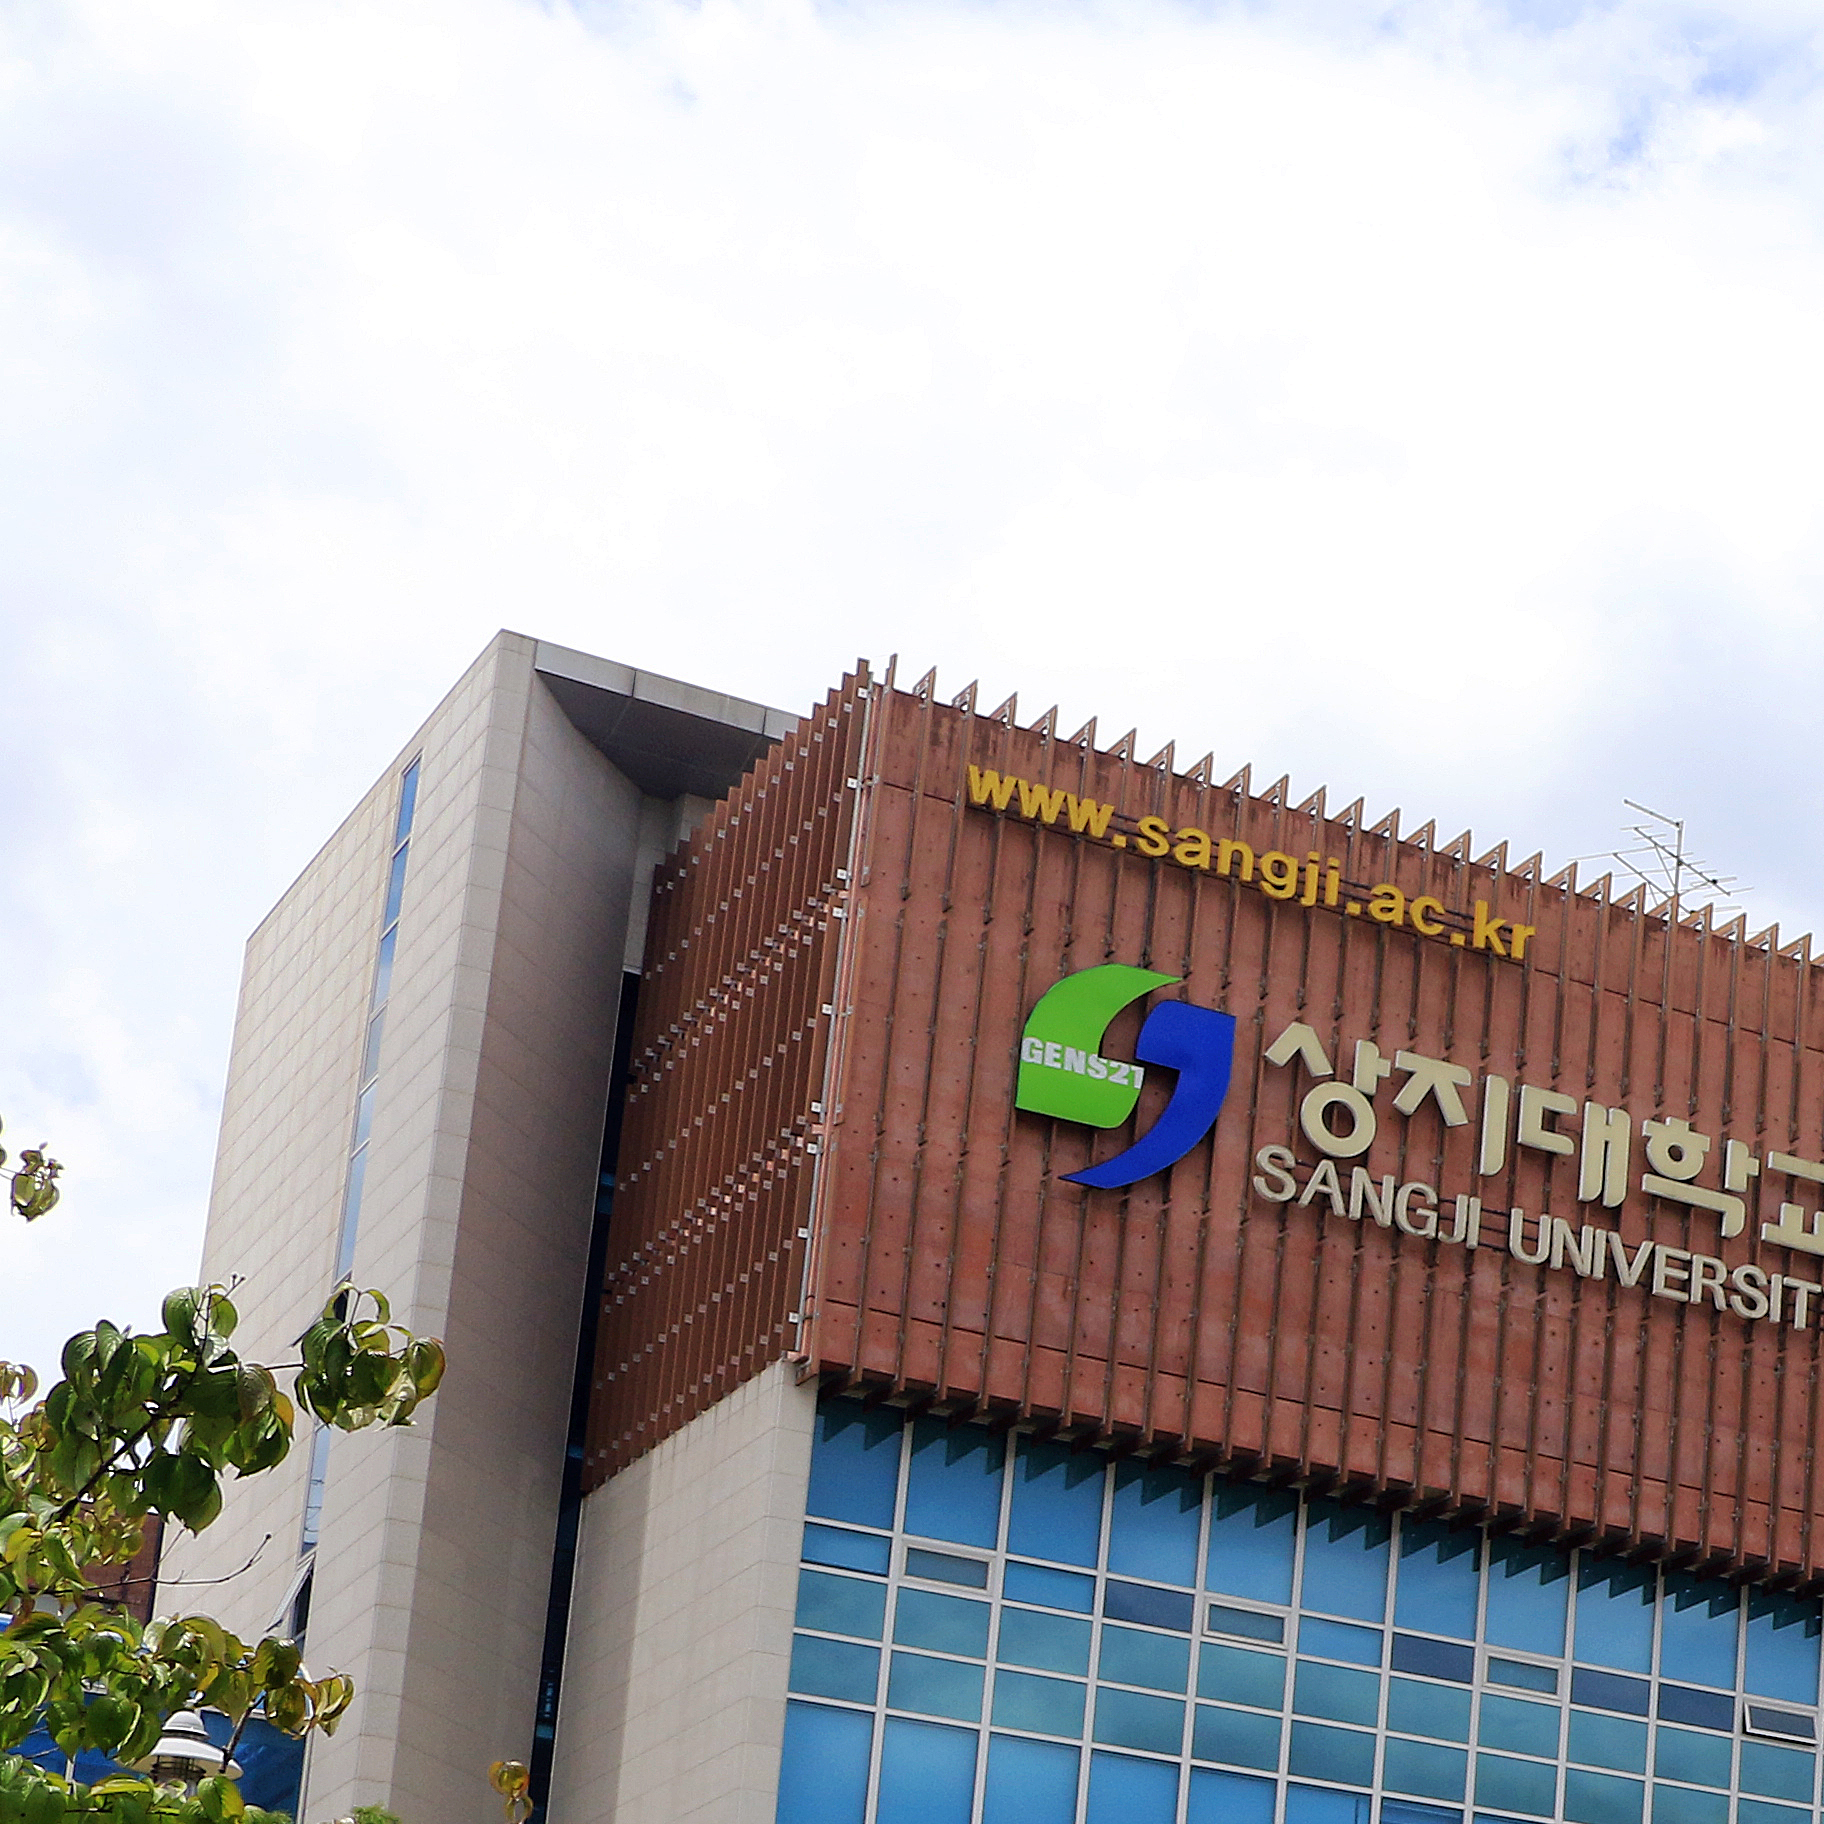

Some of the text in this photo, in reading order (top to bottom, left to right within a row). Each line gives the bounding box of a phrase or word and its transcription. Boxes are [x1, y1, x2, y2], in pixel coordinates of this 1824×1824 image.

[967, 763, 1537, 961] www.sangji.ac.kr
[1021, 1036, 1145, 1089] GENS21
[1252, 1144, 1482, 1250] SANGJI
